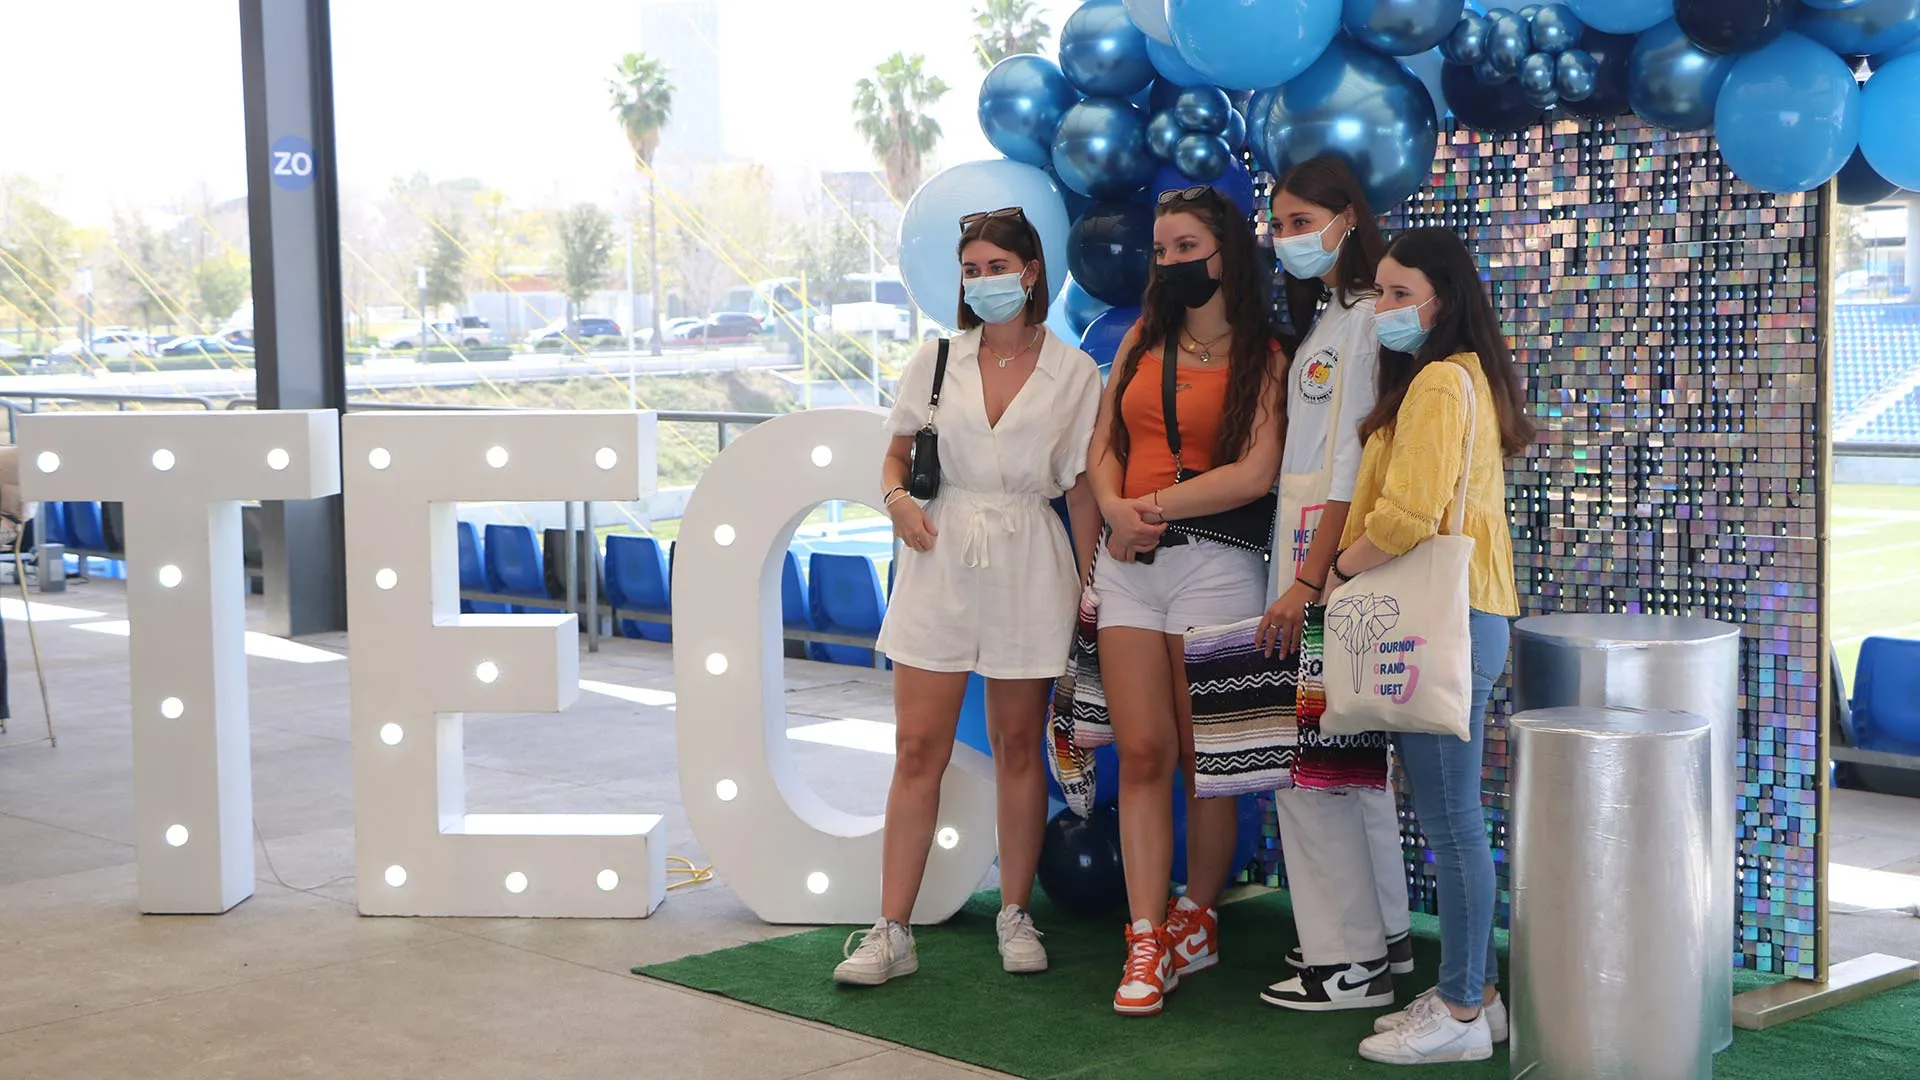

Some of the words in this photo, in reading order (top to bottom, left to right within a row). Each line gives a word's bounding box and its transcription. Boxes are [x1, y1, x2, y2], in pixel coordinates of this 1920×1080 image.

[274, 151, 312, 176] ZO
[1294, 528, 1309, 544] WE
[1373, 640, 1415, 654] TOURNOI
[18, 408, 999, 924] TEC
[1373, 661, 1406, 675] GRAND
[1373, 683, 1403, 696] OUEST
